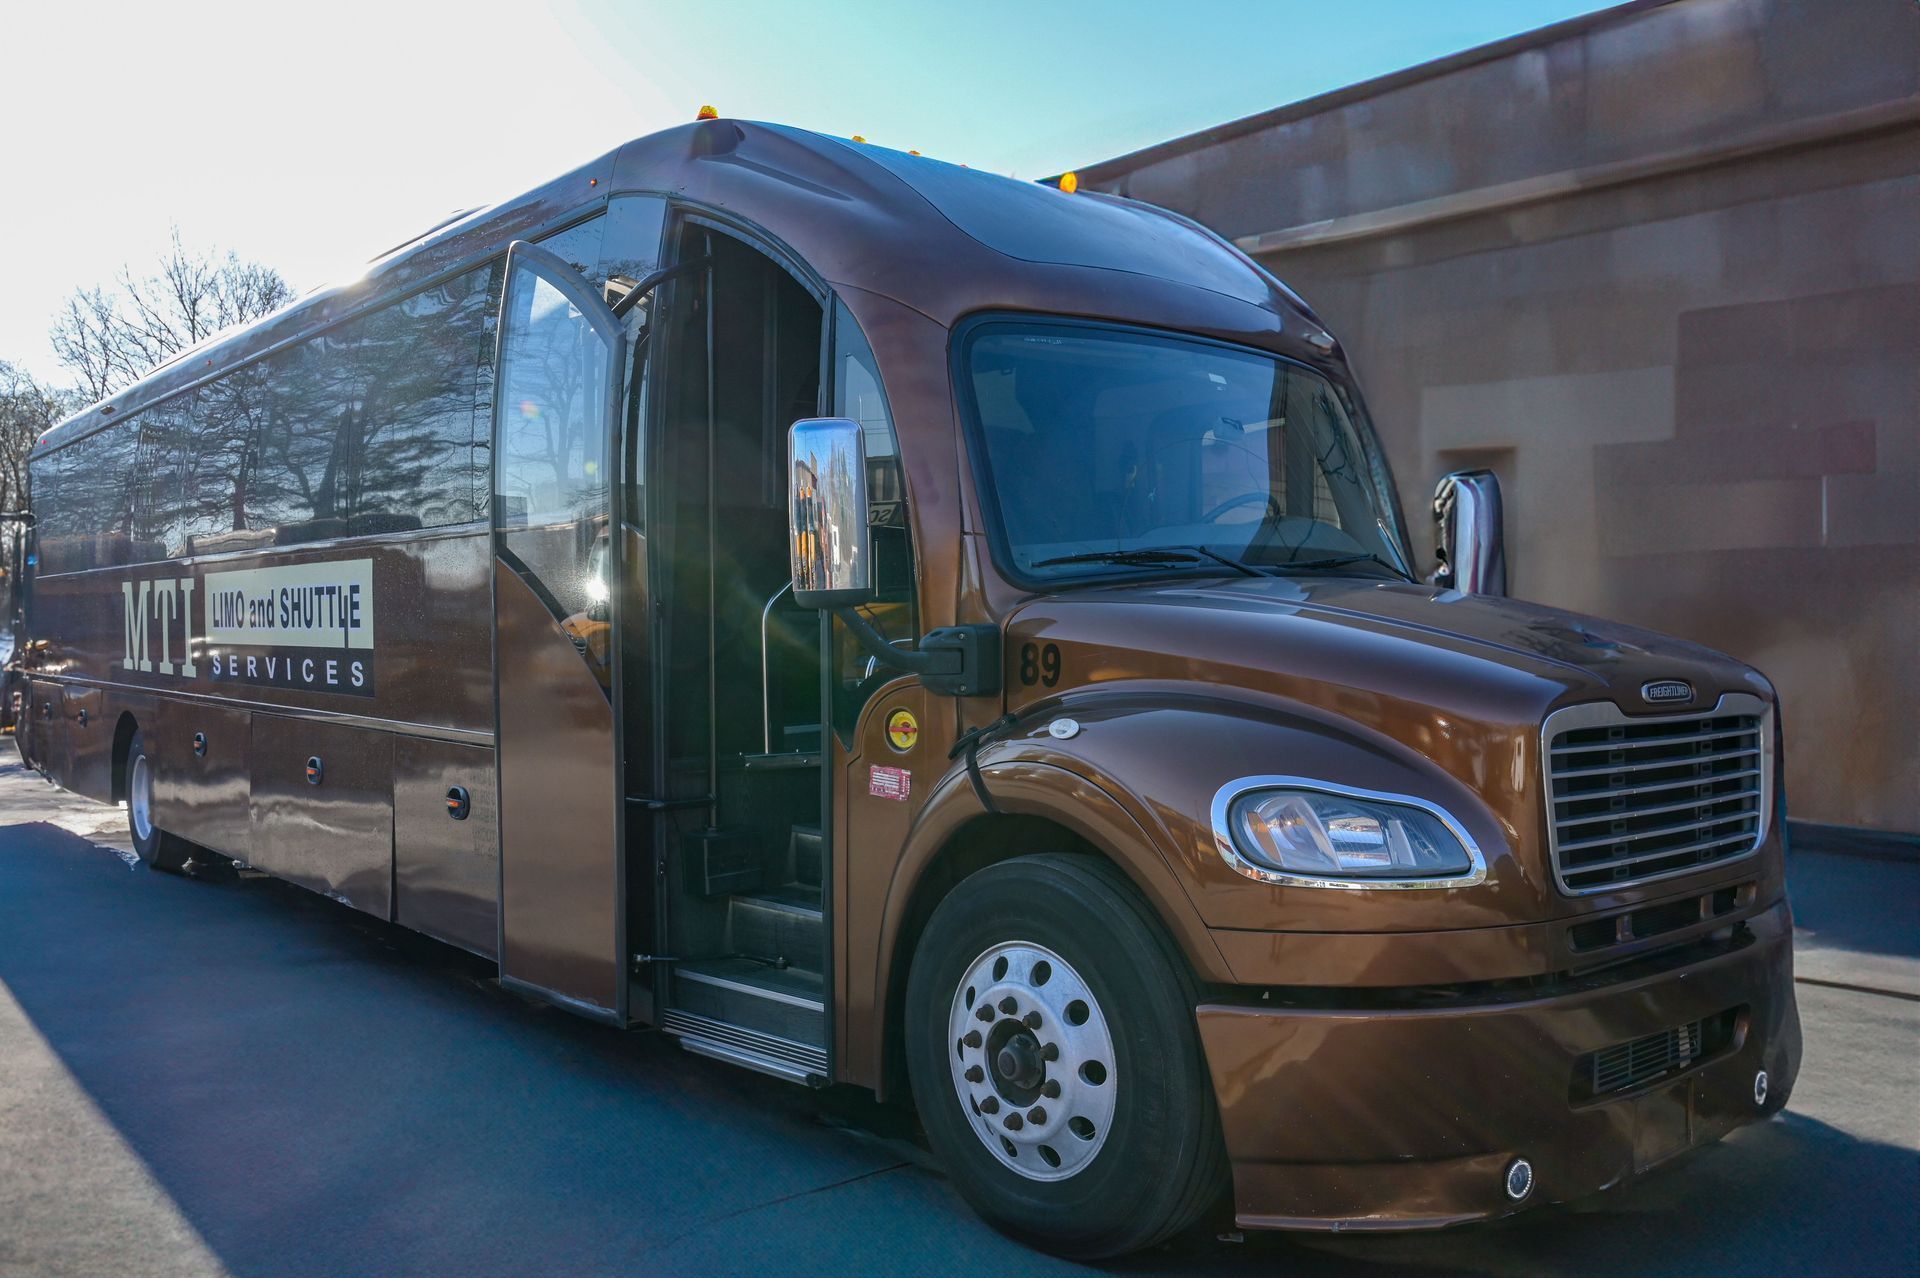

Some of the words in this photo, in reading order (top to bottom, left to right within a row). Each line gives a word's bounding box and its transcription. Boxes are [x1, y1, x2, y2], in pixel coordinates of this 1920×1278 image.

[122, 578, 196, 678] MTI
[212, 590, 245, 628] LIMO
[249, 589, 275, 628] and
[280, 584, 361, 629] SHUTTLE
[212, 654, 364, 687] SERVICES
[1021, 642, 1061, 688] 89
